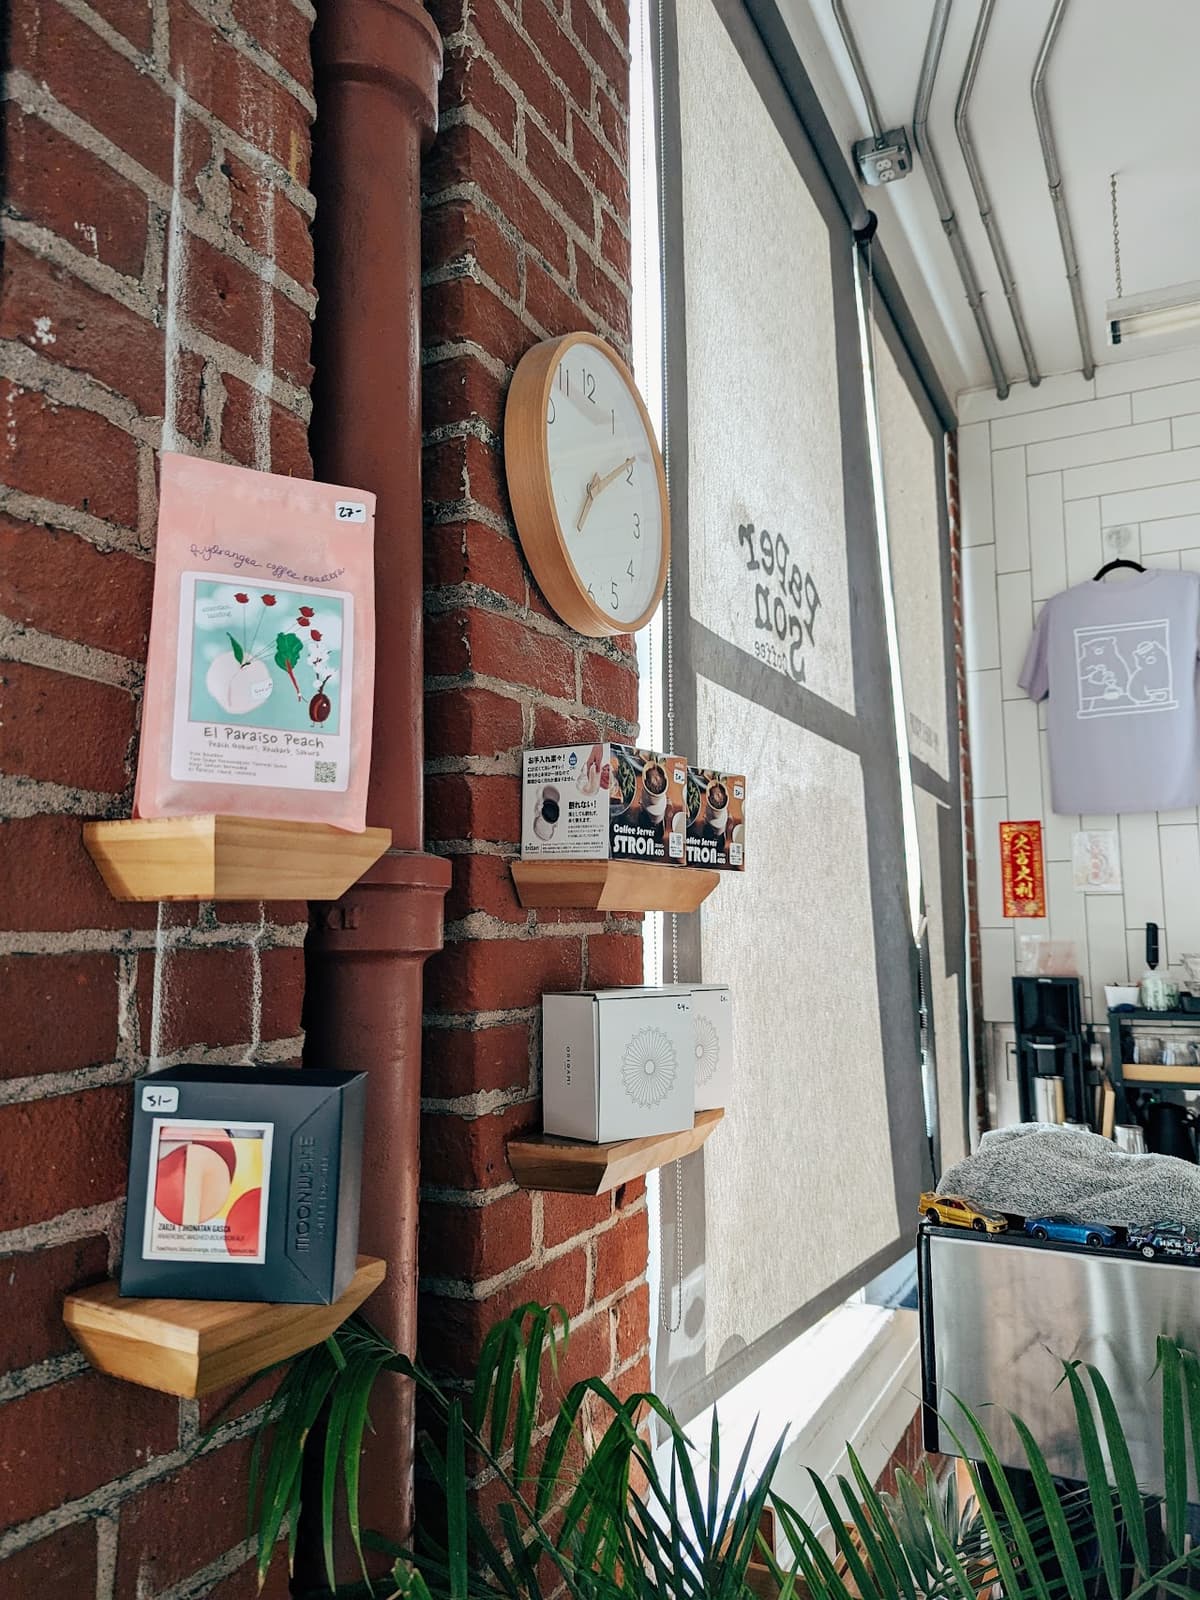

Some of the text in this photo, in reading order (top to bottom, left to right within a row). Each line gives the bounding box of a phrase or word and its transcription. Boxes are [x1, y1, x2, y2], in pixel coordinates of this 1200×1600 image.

[558, 363, 570, 397] 11
[582, 368, 596, 404] 12
[610, 408, 616, 436] 1
[625, 458, 634, 486] 2
[338, 506, 362, 518] 27-
[633, 512, 641, 539] 3
[626, 559, 635, 582] 4
[610, 581, 619, 610] 5
[203, 726, 325, 749] El Paraiso Peach
[613, 823, 636, 835] Coffee
[636, 825, 655, 836] Server
[686, 837, 718, 847] offee Server
